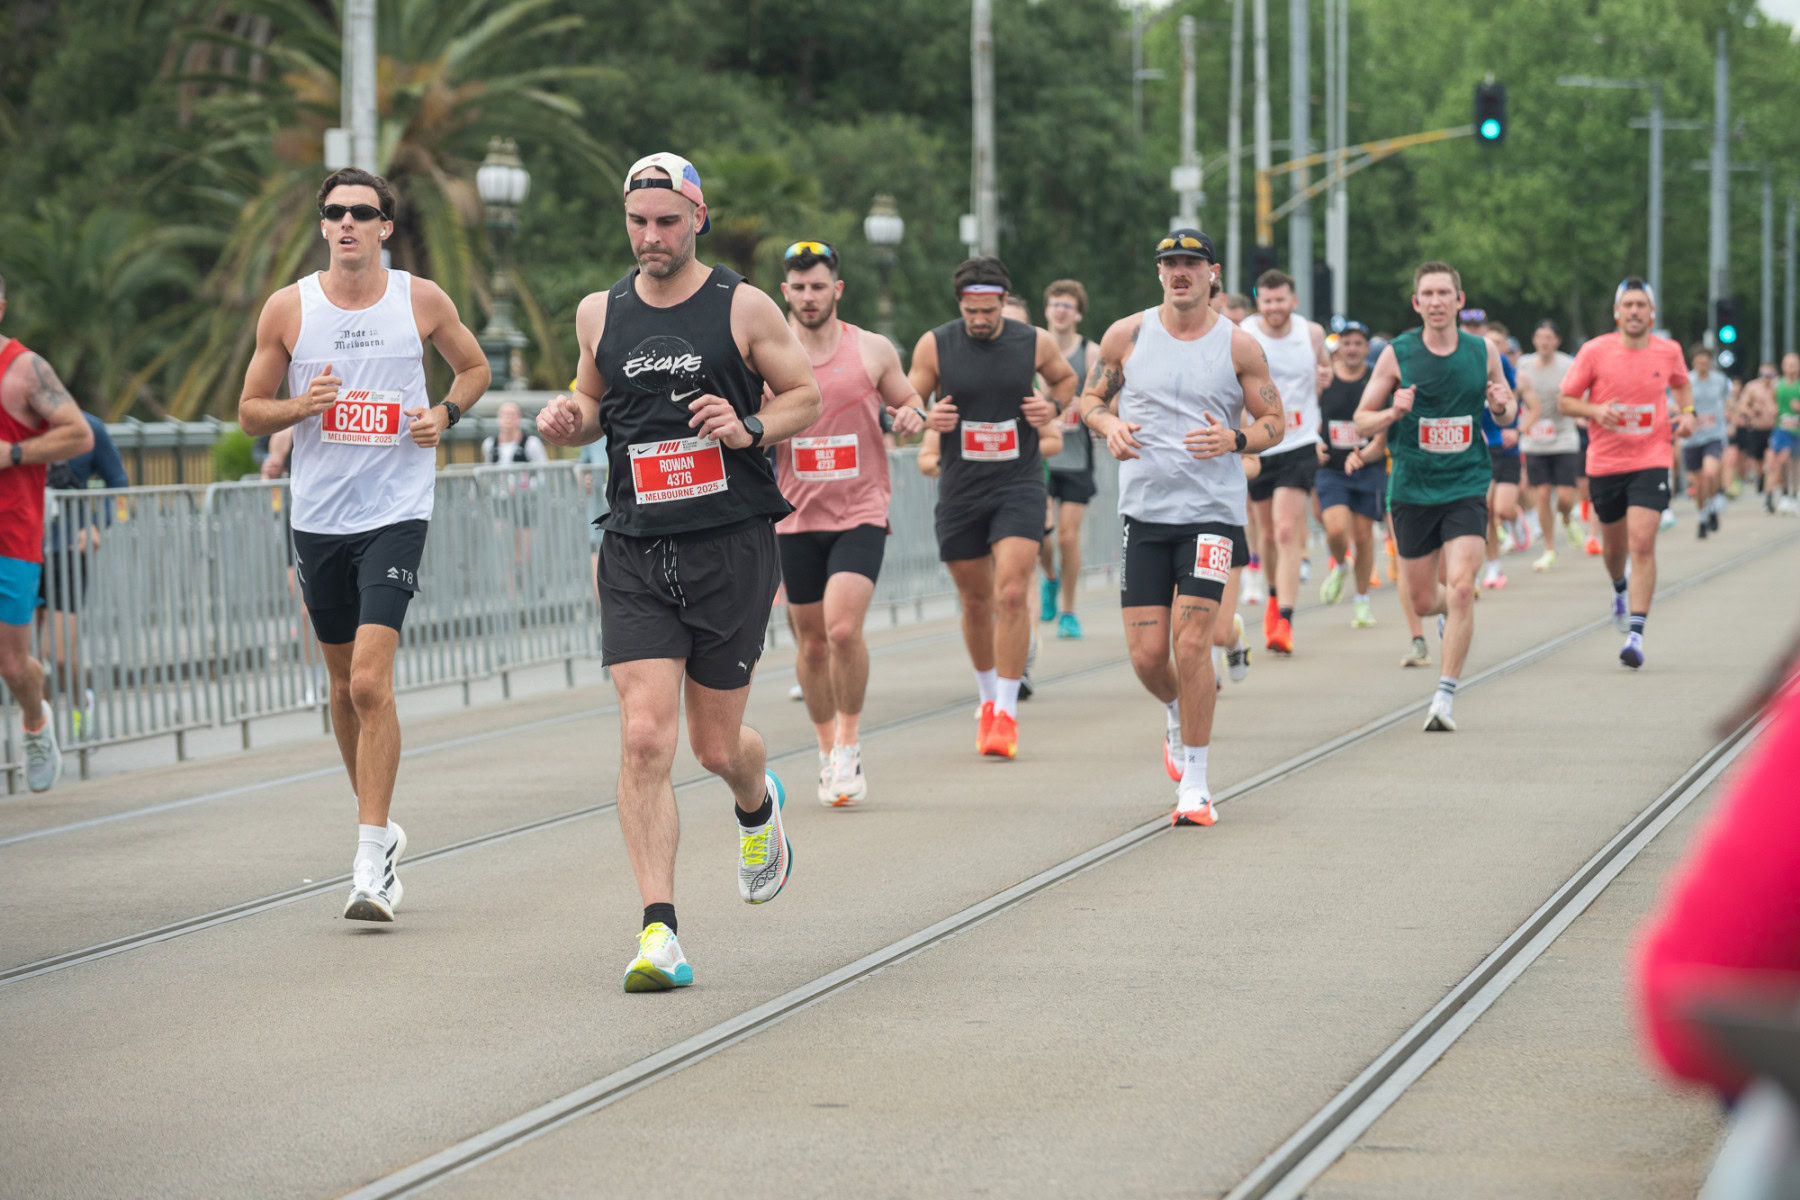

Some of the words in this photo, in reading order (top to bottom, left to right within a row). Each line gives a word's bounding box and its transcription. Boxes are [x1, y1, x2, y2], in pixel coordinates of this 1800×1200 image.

[622, 354, 702, 378] ESCAPE
[335, 403, 388, 433] 6205
[328, 432, 372, 443] MELBOURNE
[374, 435, 393, 443] 2025
[1429, 426, 1464, 444] 9306
[659, 455, 695, 473] ROWAN
[666, 471, 693, 487] 4376
[645, 487, 695, 502] MELBOURNE
[697, 482, 719, 494] 2025
[401, 568, 414, 585] T8
